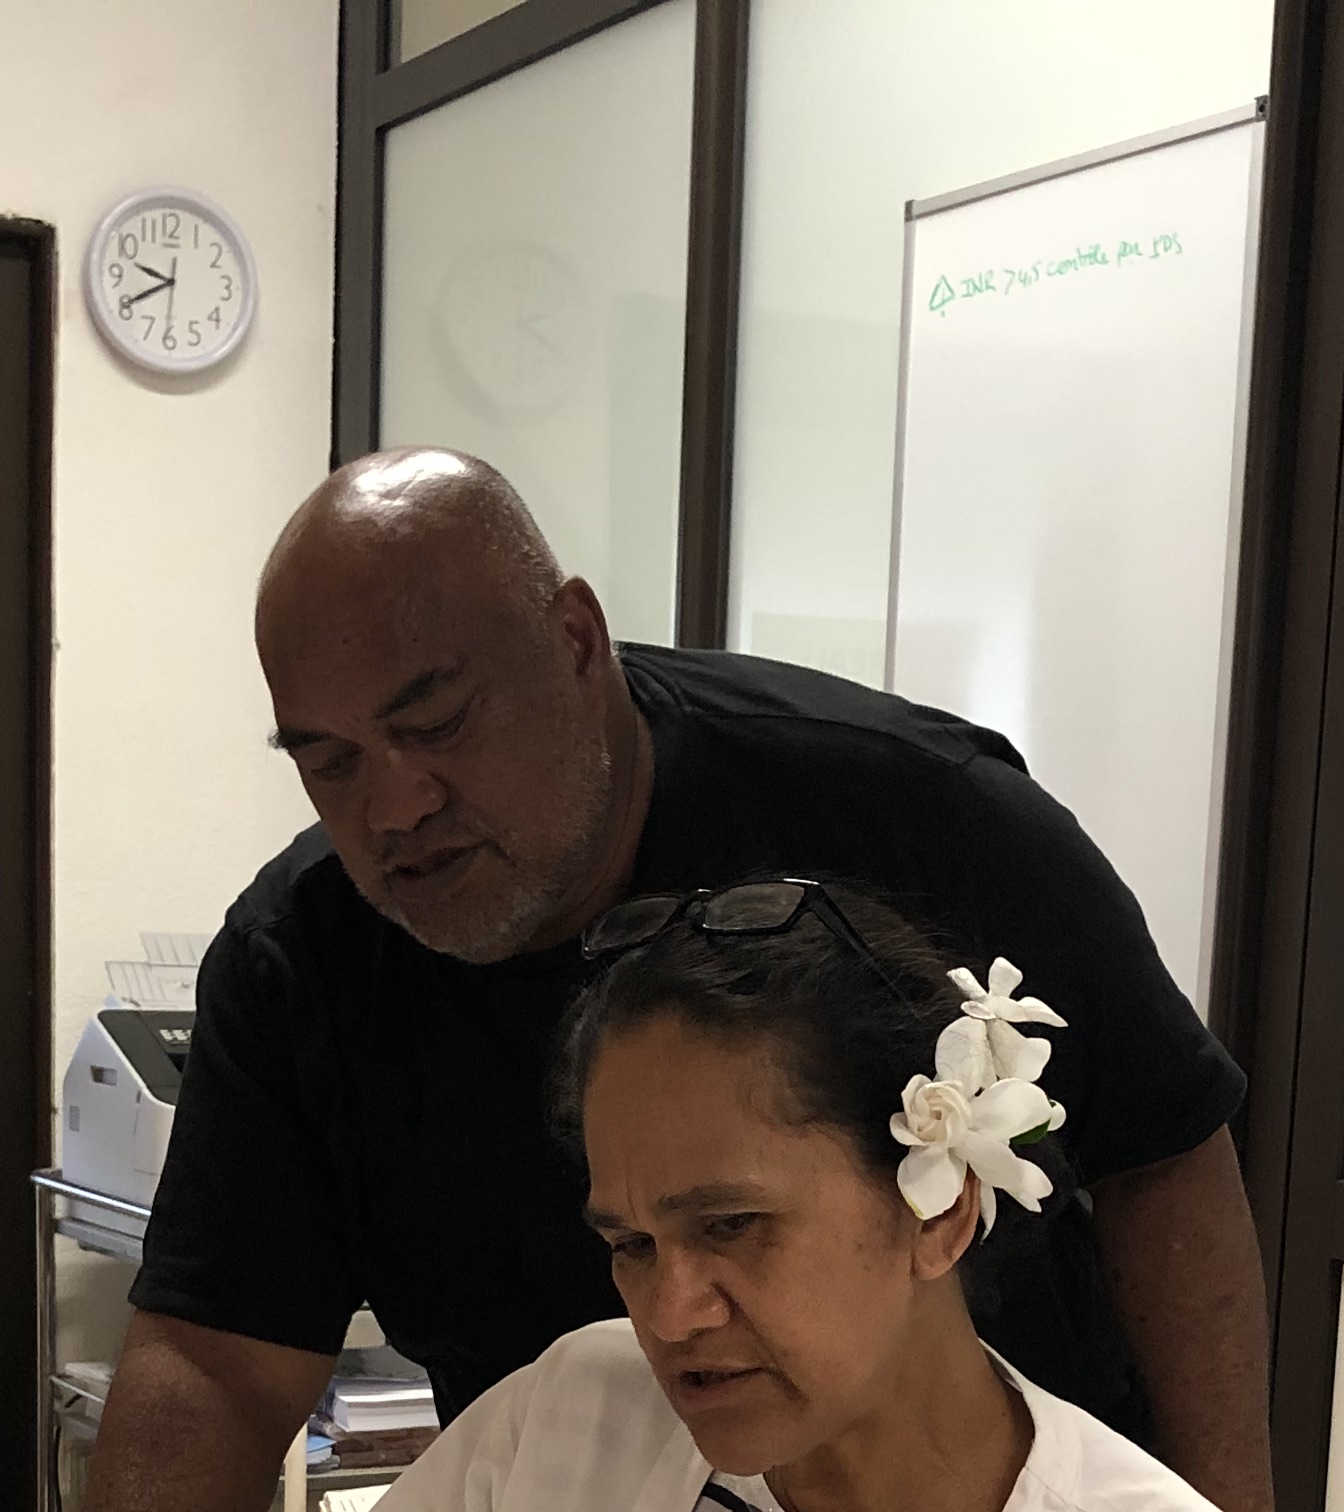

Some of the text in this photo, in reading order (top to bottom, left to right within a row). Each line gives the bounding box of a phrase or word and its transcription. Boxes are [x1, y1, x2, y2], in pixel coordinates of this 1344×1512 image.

[141, 217, 157, 243] 11
[161, 212, 181, 239] 12
[192, 224, 200, 249] 1
[118, 233, 139, 260] 10
[209, 242, 224, 268] 2
[108, 263, 124, 289] 9
[220, 275, 233, 301] 3
[118, 294, 134, 321] 8
[207, 306, 222, 330] 4
[140, 315, 156, 341] 7
[162, 325, 178, 351] 6
[187, 320, 202, 346] 5
